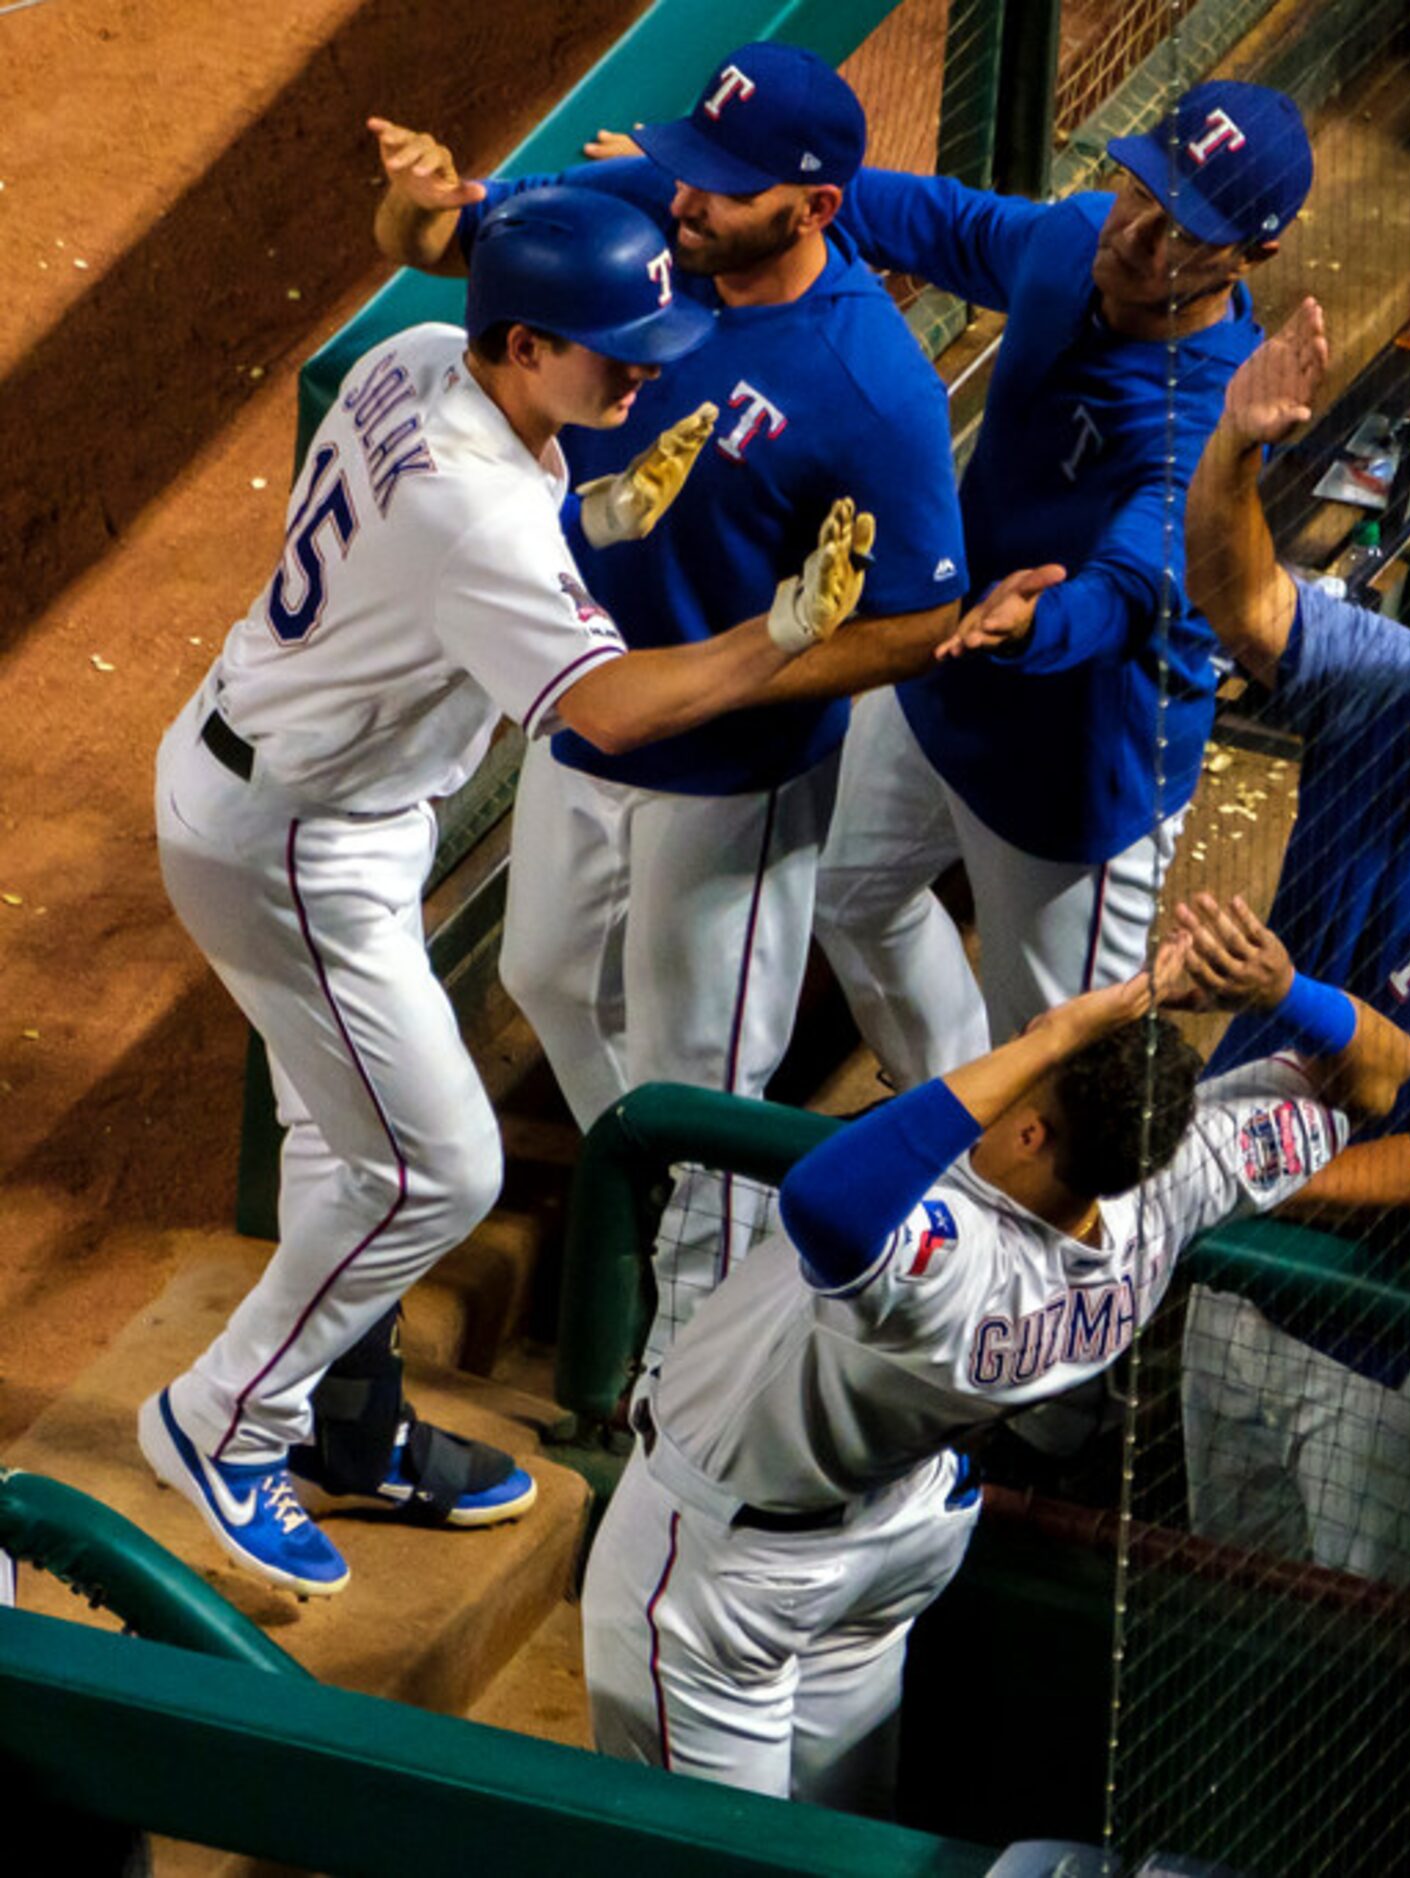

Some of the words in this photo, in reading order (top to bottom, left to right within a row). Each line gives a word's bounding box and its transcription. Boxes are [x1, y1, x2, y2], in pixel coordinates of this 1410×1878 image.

[704, 65, 754, 121] T
[1188, 108, 1246, 167] T
[646, 248, 673, 308] T
[342, 350, 438, 520] SOLAK
[715, 379, 788, 464] T
[1061, 403, 1105, 482] T
[265, 441, 360, 648] 15
